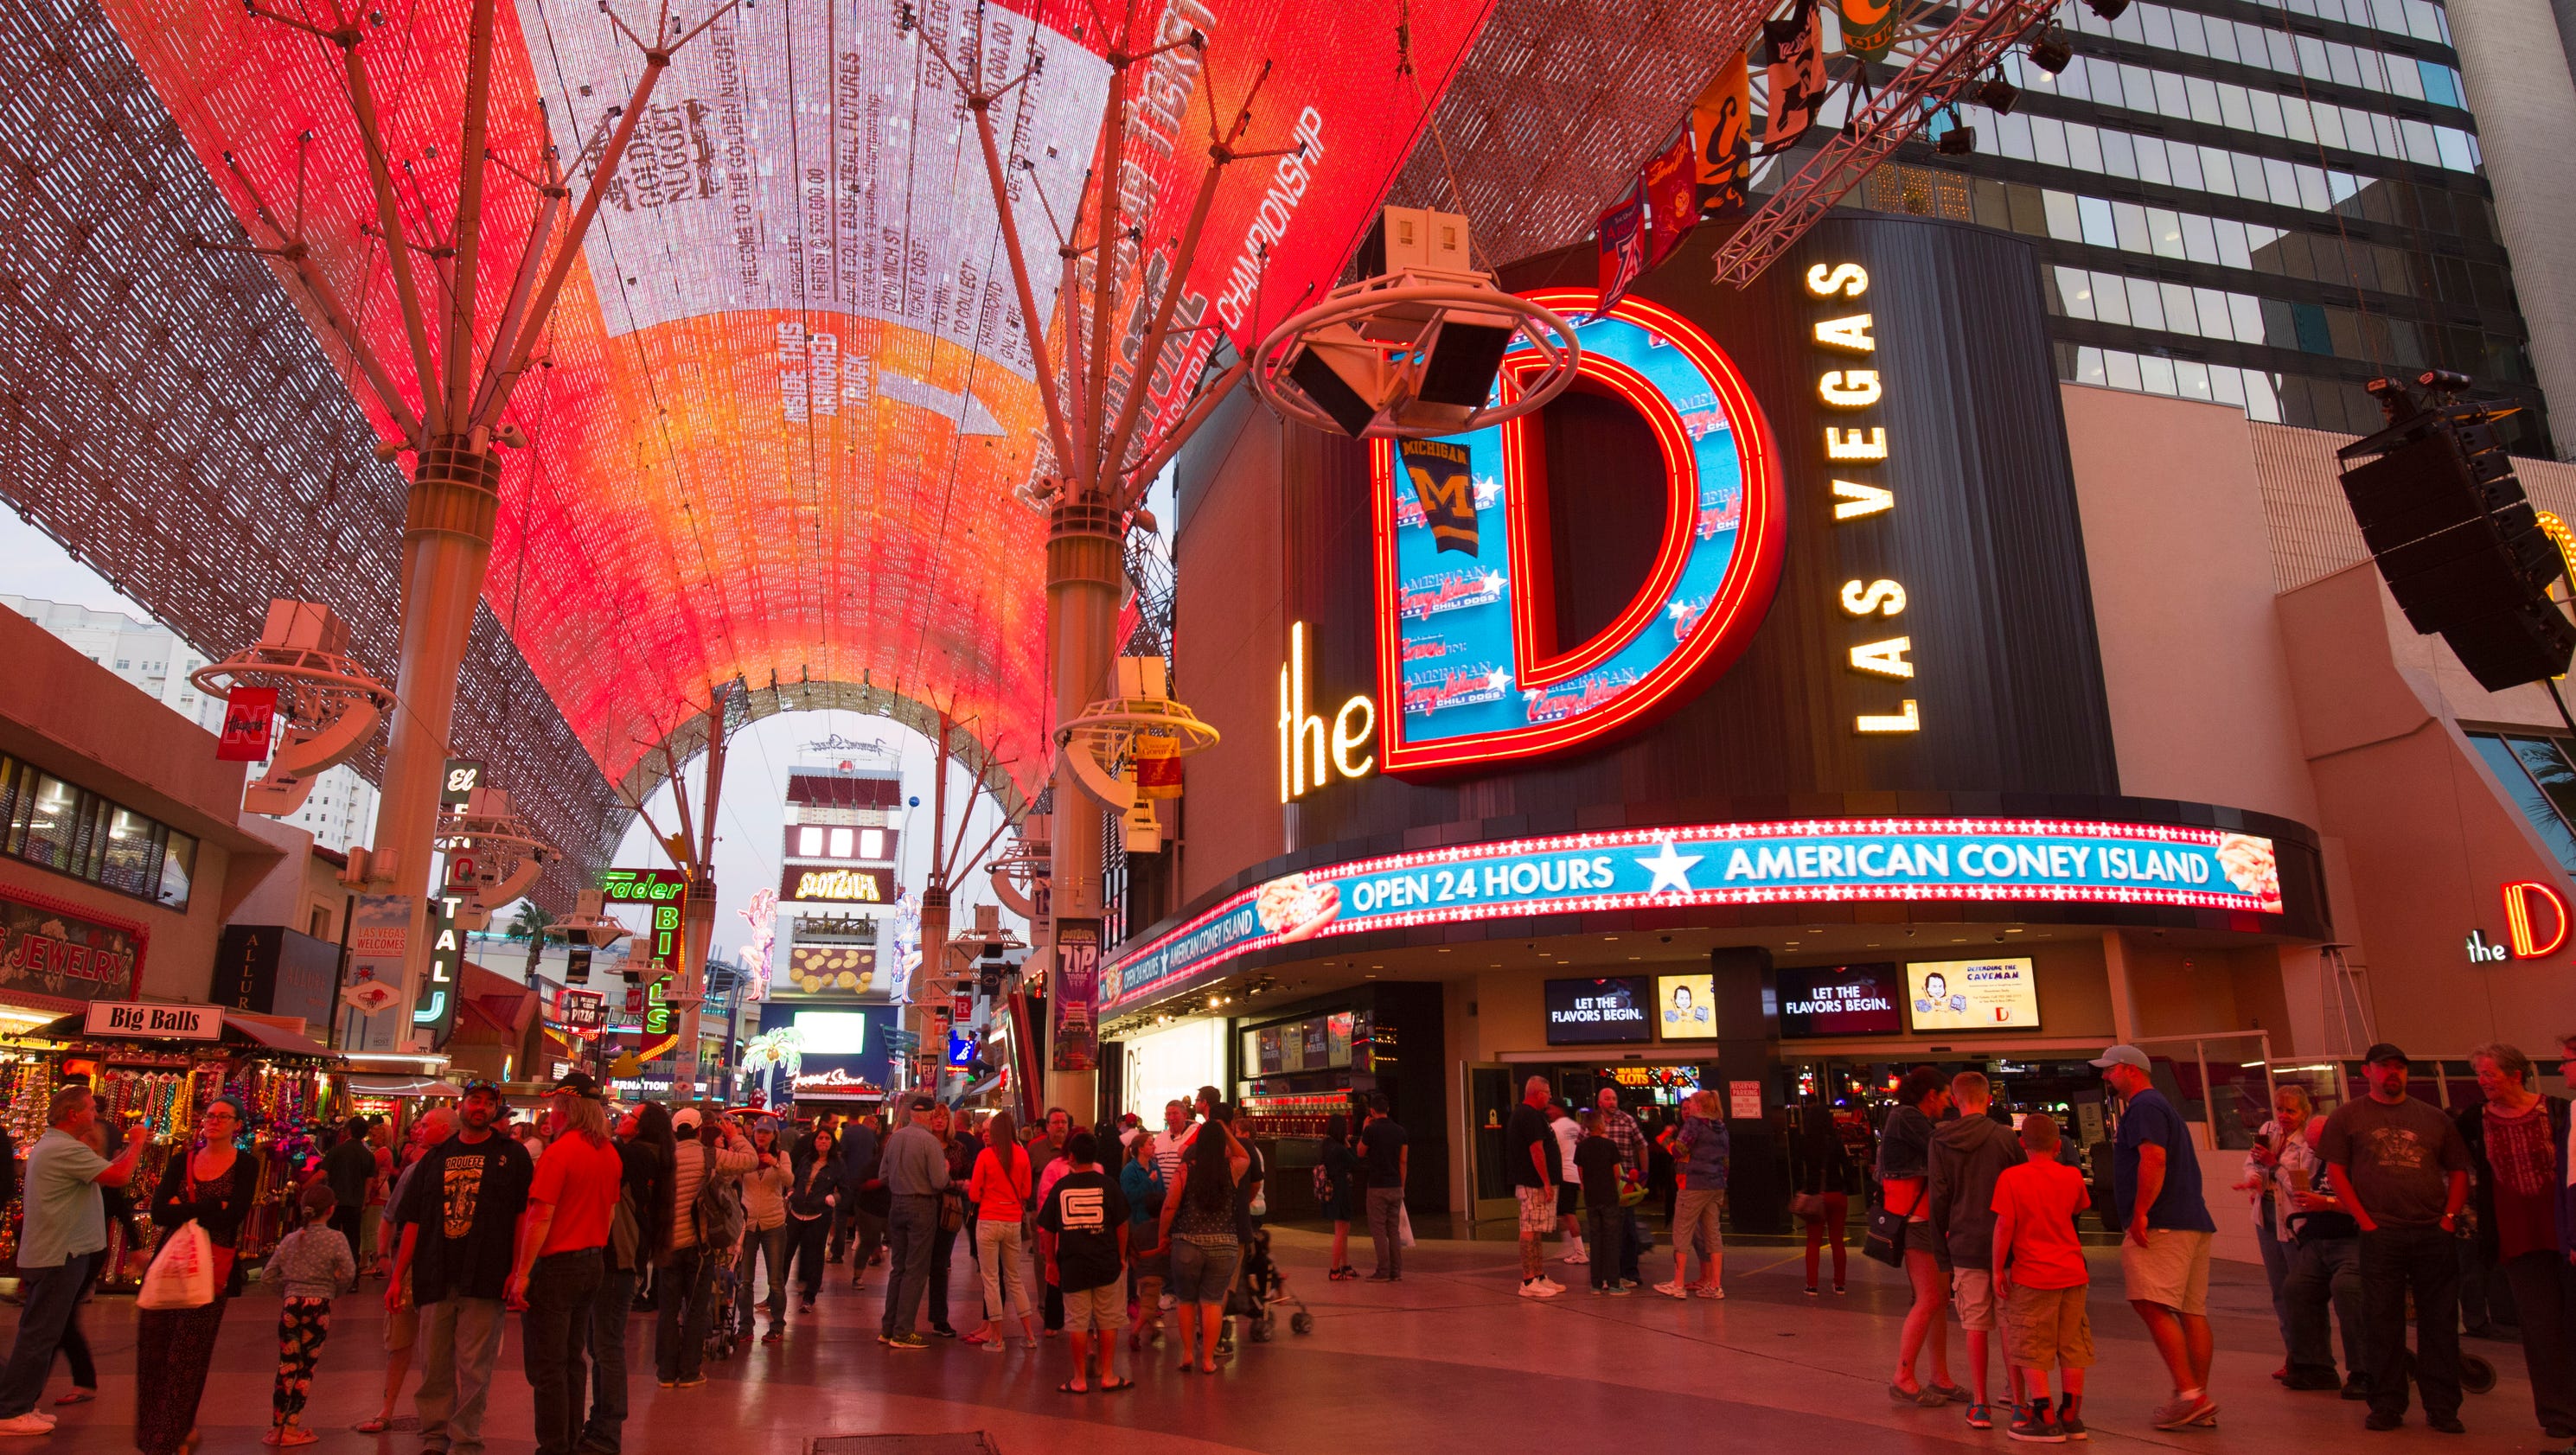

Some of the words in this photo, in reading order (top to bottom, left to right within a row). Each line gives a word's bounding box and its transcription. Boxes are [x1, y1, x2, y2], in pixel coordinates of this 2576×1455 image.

[710, 23, 738, 99] NUGGET
[839, 51, 860, 131] FUTURES
[721, 103, 747, 169] GOLDEN
[650, 103, 693, 204] NUGGET
[729, 172, 750, 200] THE
[840, 137, 860, 230] BASKETBALL
[734, 204, 751, 222] TO
[1216, 105, 1324, 332] CHAMPIONSHIP
[777, 321, 806, 361] THIS
[812, 332, 838, 418] ARMORED
[842, 351, 870, 407] TRUCK
[1806, 263, 1895, 524] VEGAS
[1403, 441, 1467, 465] MICHIGAN
[1407, 466, 1474, 518] M
[1278, 621, 1375, 804] the
[1370, 287, 1787, 773] D
[1403, 565, 1487, 590] AMERICAN
[1432, 600, 1461, 611] CHILI
[1463, 594, 1496, 606] DOGS
[1839, 578, 1921, 734] LAS
[1407, 661, 1492, 686] AMERICAN
[1436, 697, 1466, 708] CHILI
[1468, 691, 1501, 702] DOGS
[447, 769, 477, 792] El
[796, 870, 880, 902] SLOTZILLA
[1352, 877, 1429, 914] OPEN
[1435, 869, 1478, 903] 24
[1484, 856, 1615, 897] HOURS
[1724, 842, 1951, 881] AMERICAN
[1957, 843, 2091, 880] CONEY
[2098, 846, 2210, 885] ISLAND
[358, 927, 376, 939] LAS
[378, 928, 407, 940] VEGAS
[2466, 929, 2506, 963] the
[2500, 879, 2573, 960] D
[357, 938, 406, 950] WELCOMES
[1170, 935, 1200, 967] AMERICAN
[1199, 924, 1223, 954] CONEY
[1222, 909, 1253, 944] ISLAND
[11, 934, 129, 986] JEWELRY
[238, 934, 259, 1010] ALLUR
[1966, 971, 2020, 981] CAVEMAN
[957, 1000, 969, 1013] R
[1575, 998, 1595, 1010] LET
[1597, 997, 1617, 1009] THE
[1786, 1000, 1842, 1015] FLAVORS
[1845, 997, 1891, 1012] BEGIN.
[1812, 987, 1833, 1000] LET
[1837, 986, 1861, 999] THE
[110, 1007, 144, 1031] Big
[150, 1009, 201, 1032] Balls
[572, 1008, 595, 1023] PIZZA
[1551, 1010, 1601, 1023] FLAVORS
[1602, 1008, 1643, 1022] BEGIN.
[922, 1064, 938, 1074] FLY
[1614, 1073, 1650, 1085] SLOTS
